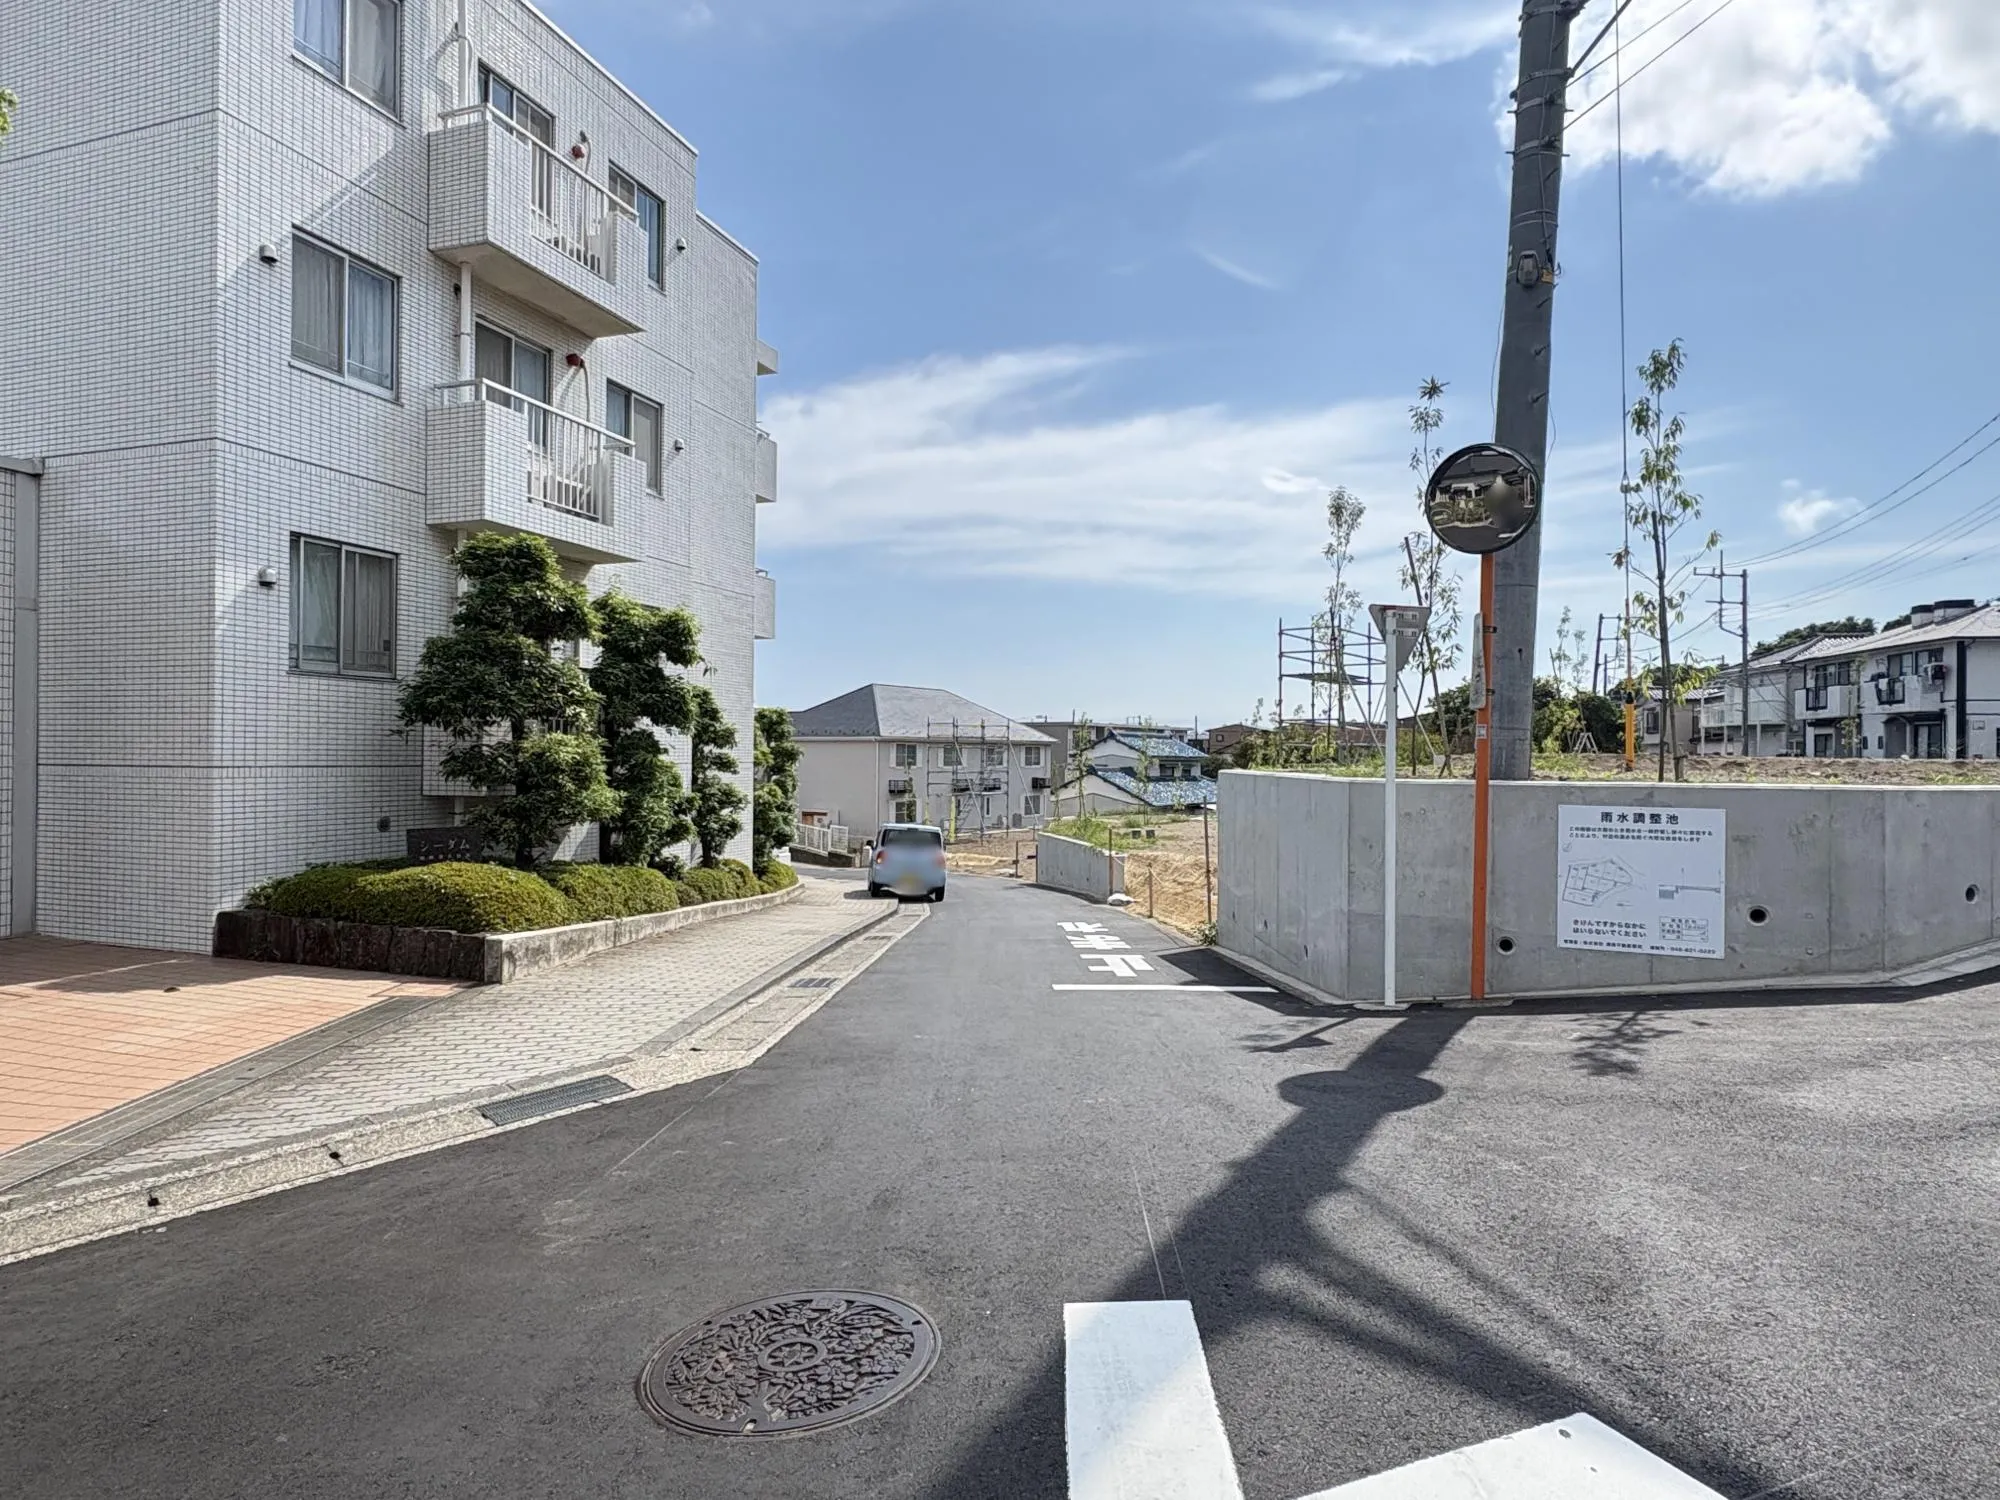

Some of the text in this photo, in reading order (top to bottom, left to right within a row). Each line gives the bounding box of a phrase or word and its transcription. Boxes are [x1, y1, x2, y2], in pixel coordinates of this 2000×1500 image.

[1601, 811, 1679, 825] 雨水調整池
[1573, 919, 1647, 930] きけんですからなかに
[1573, 927, 1647, 938] はいらないでください
[1057, 922, 1155, 977] 止まれ
